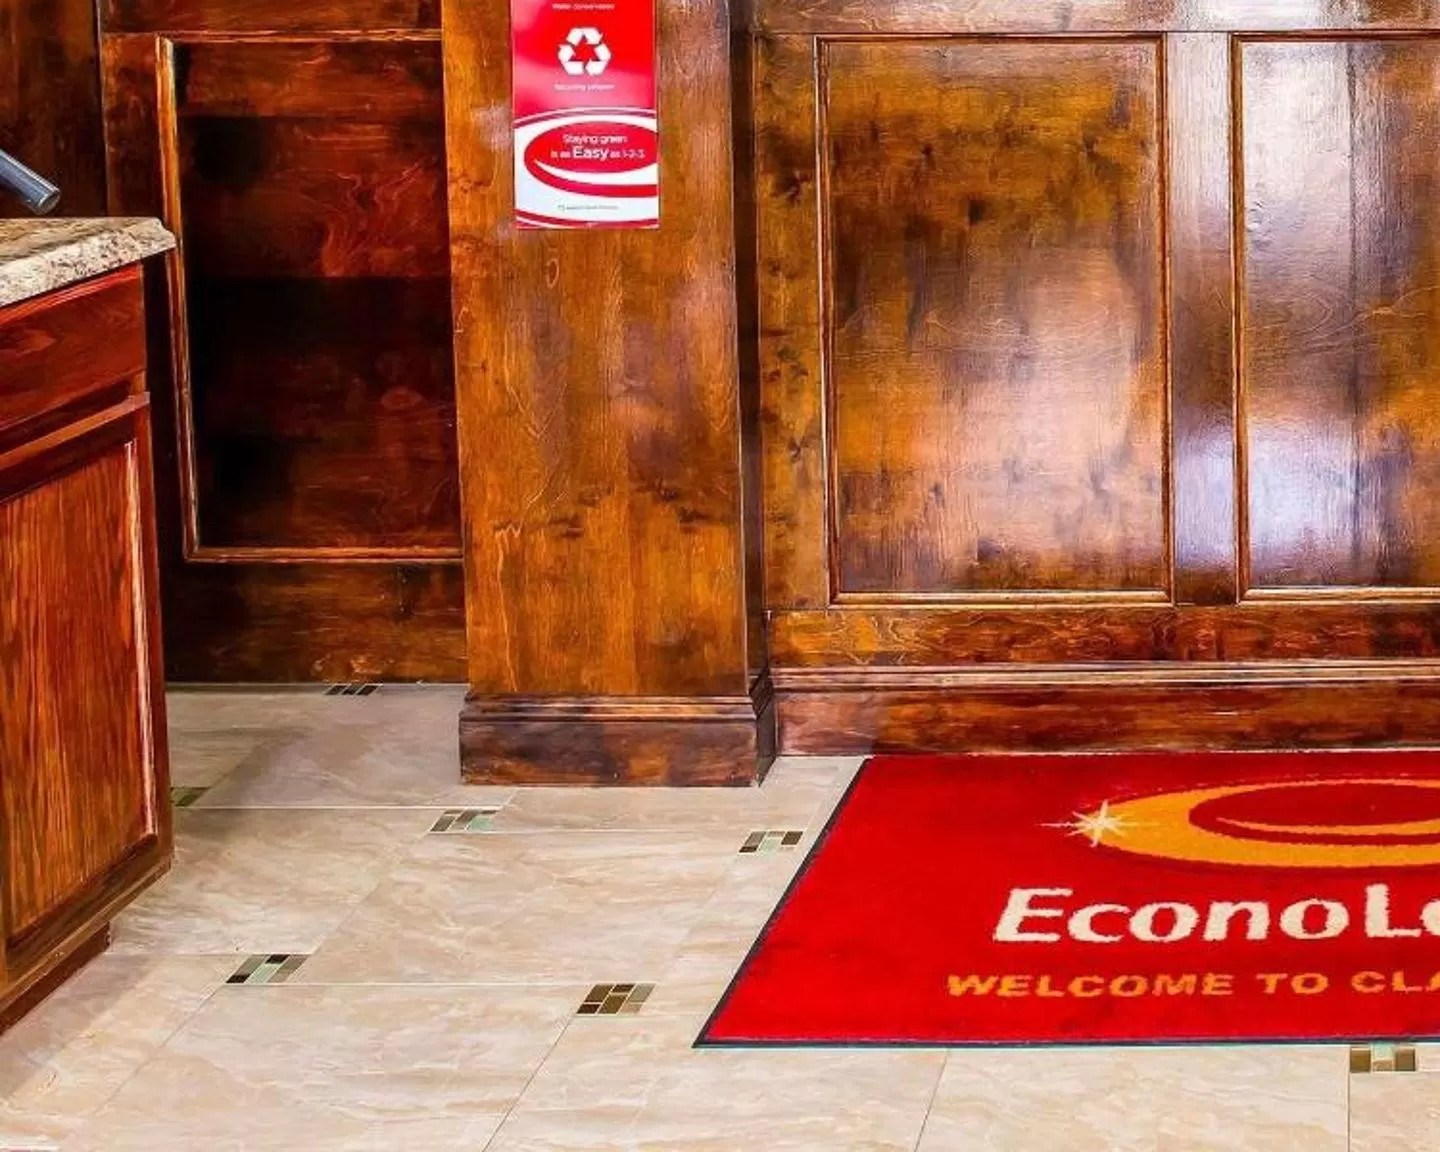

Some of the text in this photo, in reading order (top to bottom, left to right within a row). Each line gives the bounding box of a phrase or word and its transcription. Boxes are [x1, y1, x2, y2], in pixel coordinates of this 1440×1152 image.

[573, 145, 609, 161] Easy
[948, 971, 1234, 998] WELCOME
[1256, 971, 1328, 996] TO
